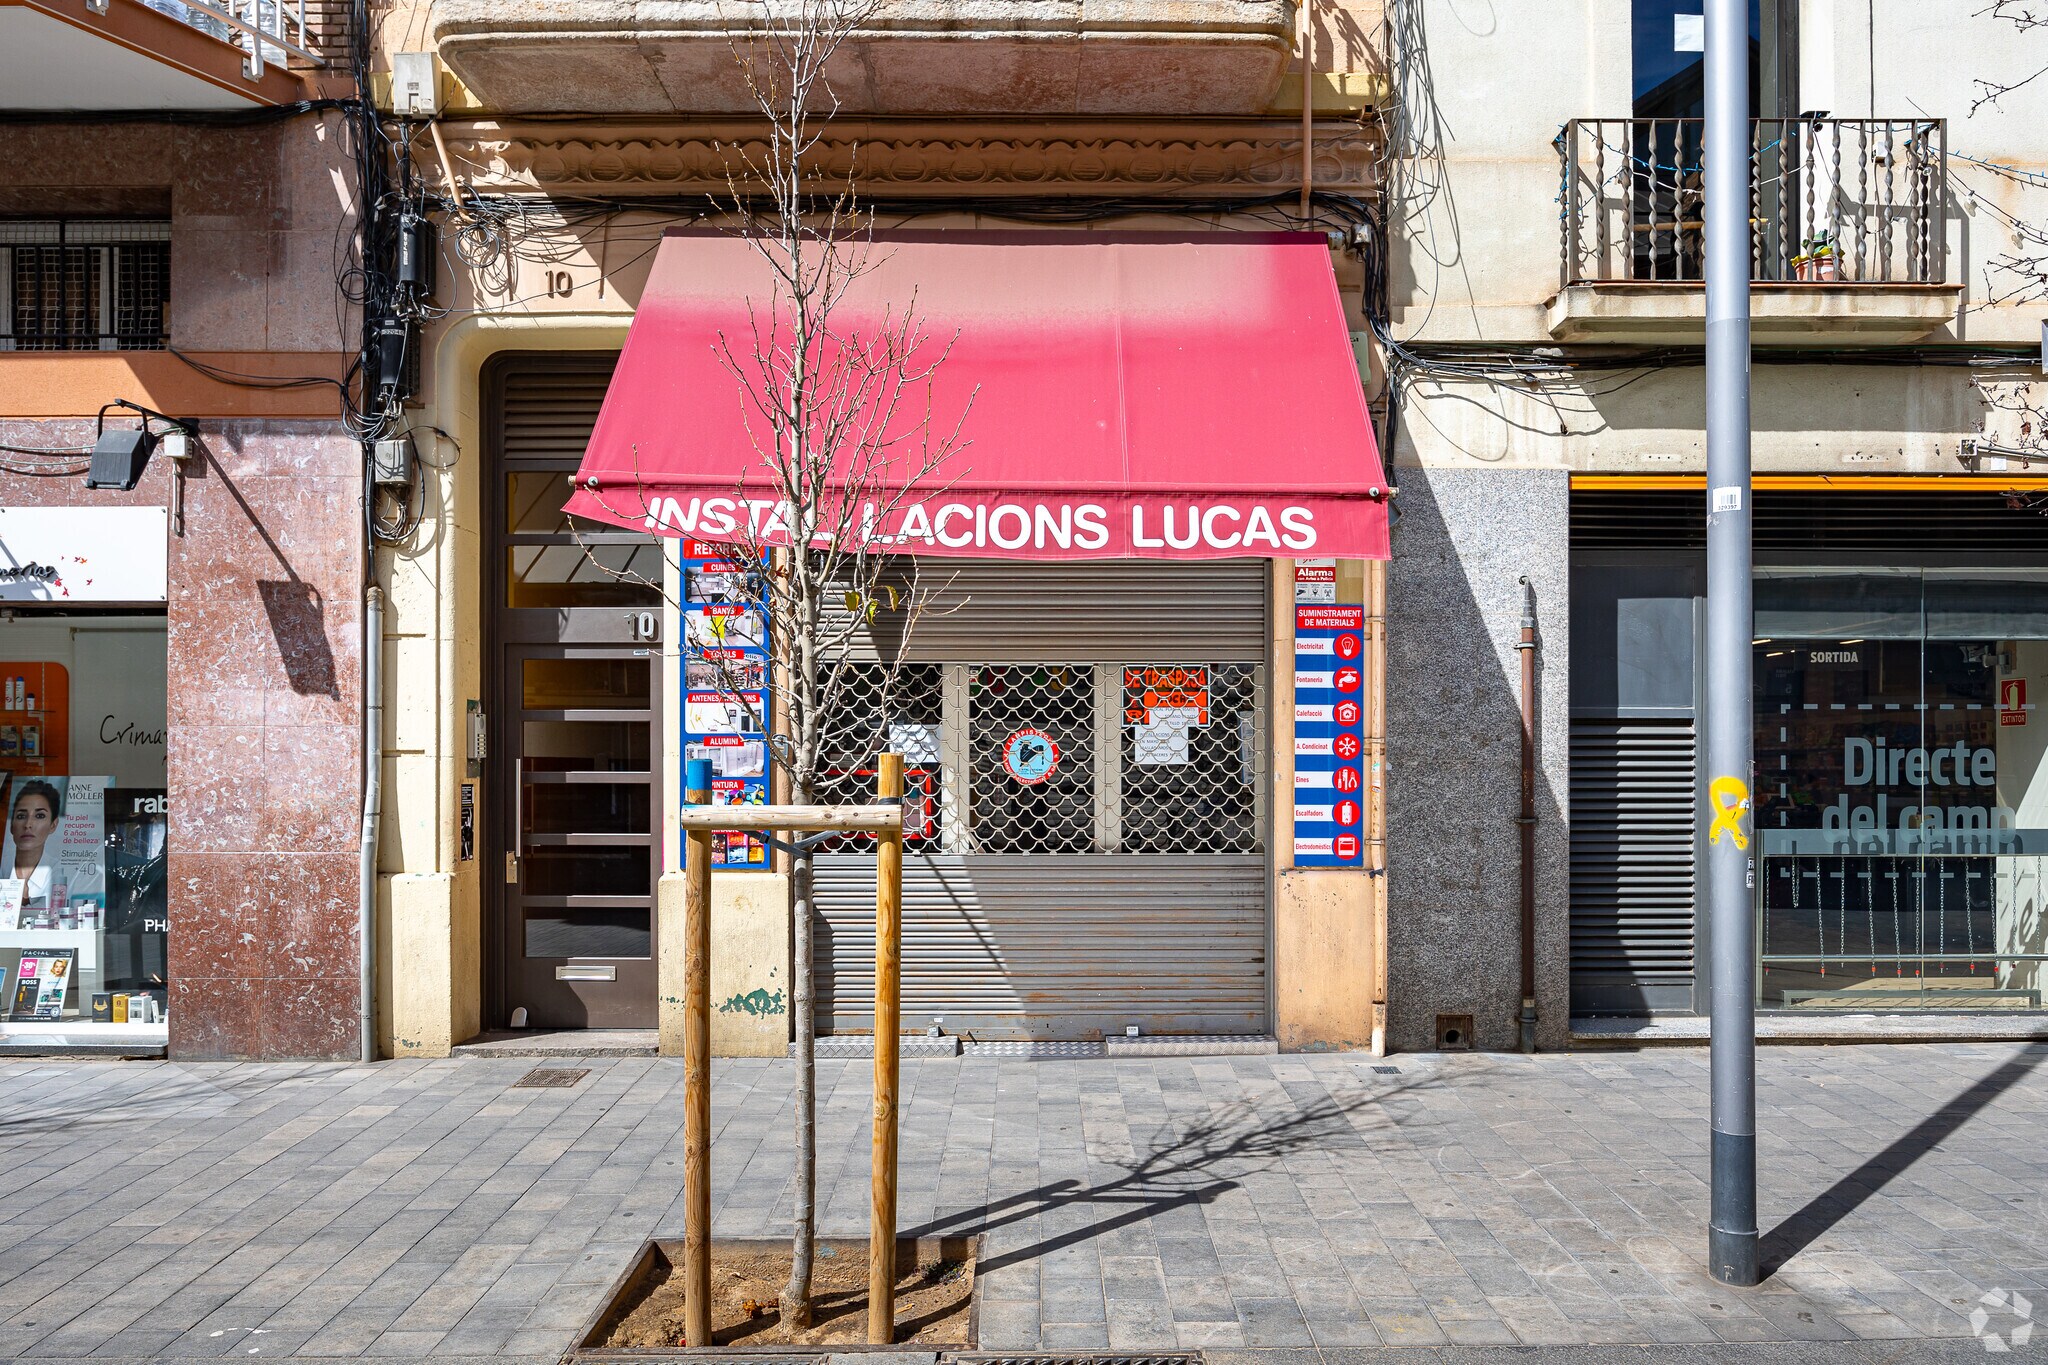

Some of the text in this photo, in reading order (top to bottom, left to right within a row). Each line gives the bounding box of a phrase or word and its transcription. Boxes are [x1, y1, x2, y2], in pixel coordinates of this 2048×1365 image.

[545, 270, 573, 299] 10
[1132, 504, 1317, 550] LUCAS
[1298, 568, 1334, 577] Alarma
[712, 607, 735, 615] BANYS
[1298, 609, 1361, 618] SUMINISTRAMENT
[624, 611, 655, 637] 10
[1304, 618, 1355, 627] DE MATERIALS
[1296, 642, 1324, 650] Electricitat
[1810, 651, 1859, 663] SORTIDA
[1296, 675, 1323, 683] Fontaneria
[1296, 709, 1323, 717] Calefacció
[2002, 715, 2025, 724] EXTINTOR
[709, 737, 739, 746] ALUMINI
[1302, 742, 1328, 750] Condicinat
[1844, 737, 1996, 786] Directe
[68, 783, 92, 792] ANNE
[711, 781, 739, 789] PINTURA
[67, 791, 104, 800] MÖLLER
[134, 795, 167, 814] rab
[1296, 809, 1324, 817] Escalfadors
[75, 814, 88, 822] piel
[1822, 793, 2017, 854] del camp
